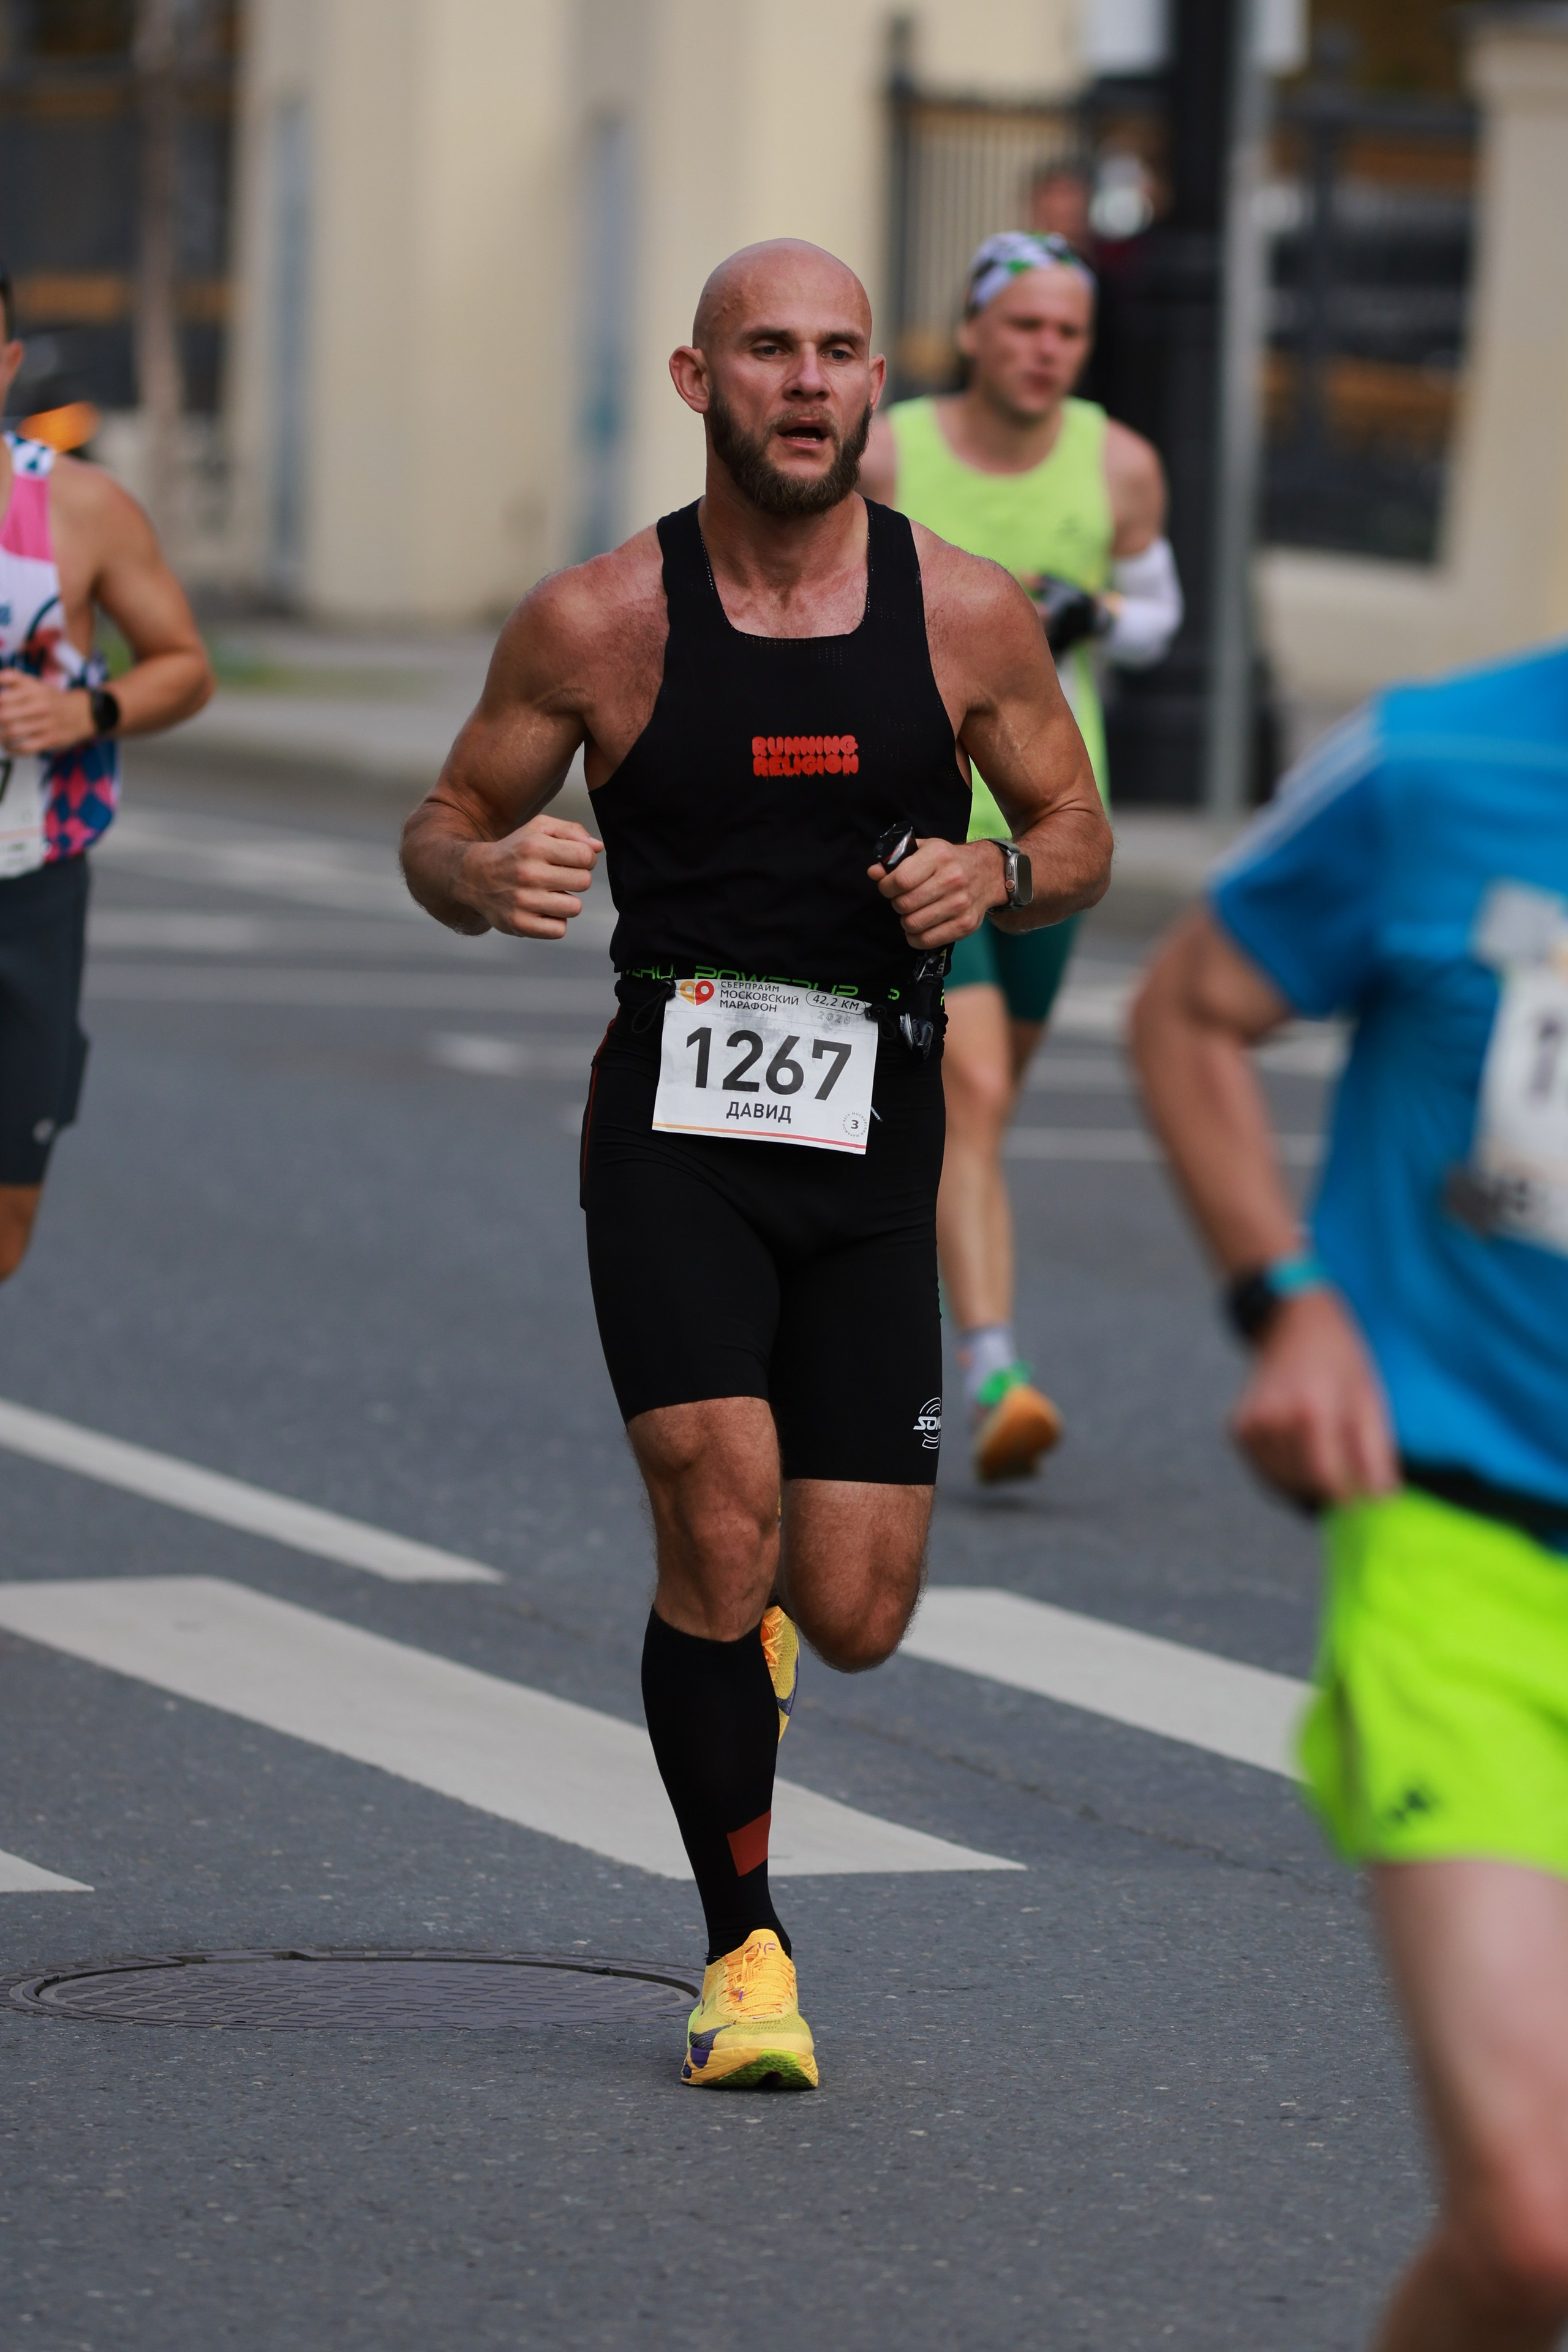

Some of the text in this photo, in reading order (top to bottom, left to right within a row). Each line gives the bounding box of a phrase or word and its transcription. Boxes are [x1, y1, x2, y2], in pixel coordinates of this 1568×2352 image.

[752, 735, 858, 756] RUNNING
[753, 754, 859, 777] RELIGION
[720, 981, 780, 992] СБЕРПРАЙМ
[720, 989, 799, 1006] МОСКОВСКИЙ
[812, 994, 837, 1008] 42,2
[719, 1000, 777, 1012] МАРАФОН
[817, 1011, 851, 1025] 2026
[686, 1027, 852, 1101] 1267
[726, 1101, 791, 1124] ДАВИД
[851, 1120, 859, 1129] 3
